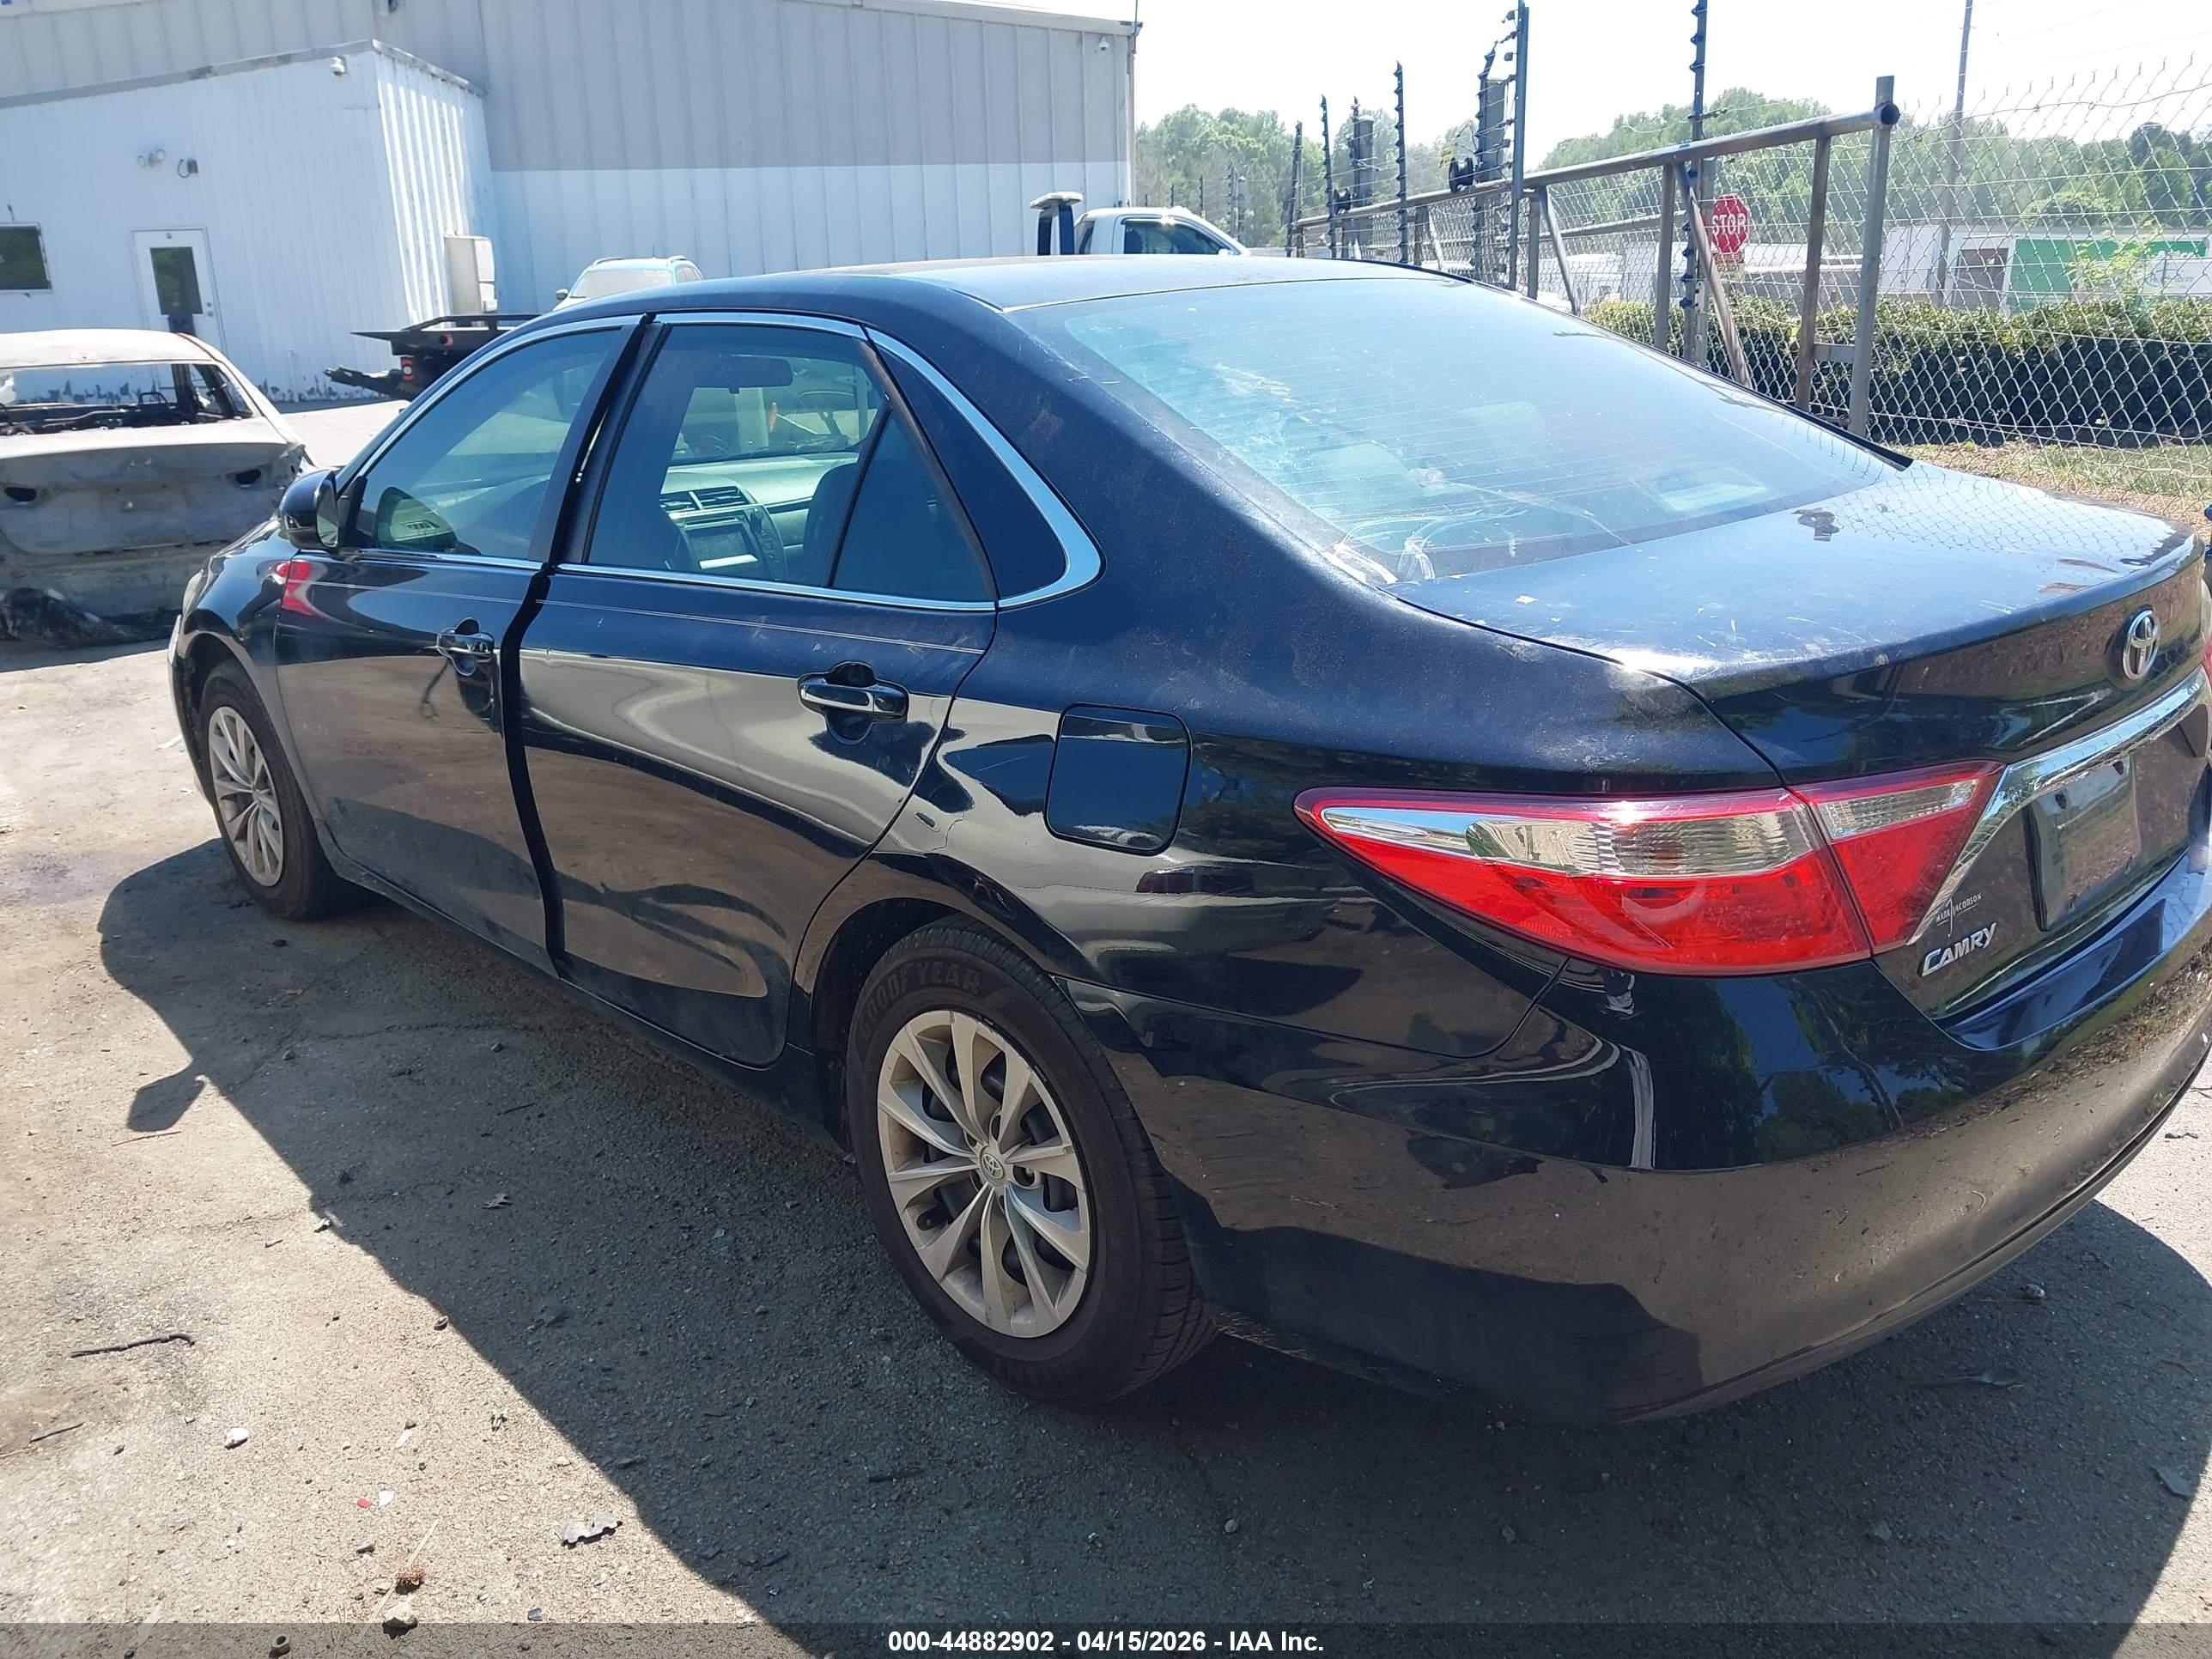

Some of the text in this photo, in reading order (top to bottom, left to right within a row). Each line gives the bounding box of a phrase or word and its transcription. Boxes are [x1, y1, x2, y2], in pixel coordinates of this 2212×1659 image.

[1712, 214, 1746, 235] STOP
[1936, 908, 1950, 922] MARK
[1922, 922, 1996, 976] CAMRY
